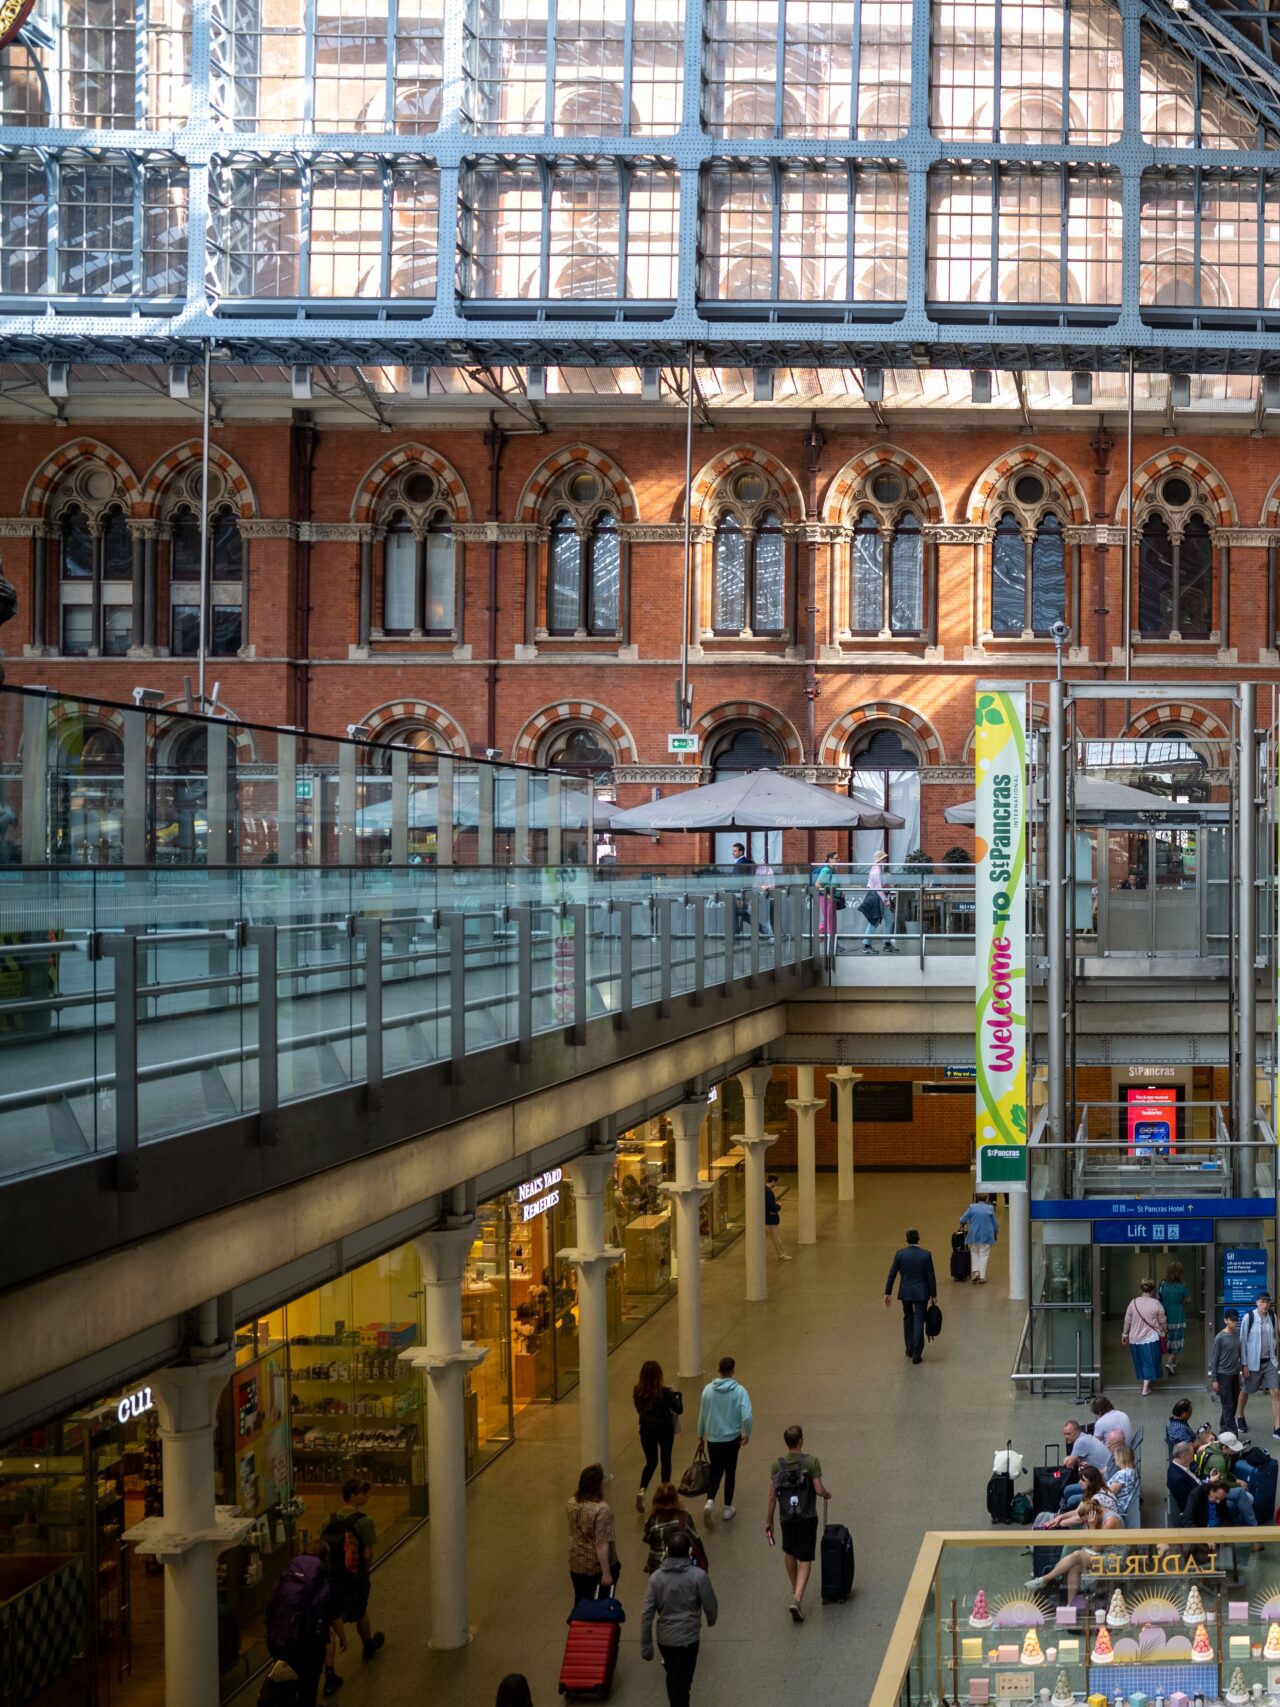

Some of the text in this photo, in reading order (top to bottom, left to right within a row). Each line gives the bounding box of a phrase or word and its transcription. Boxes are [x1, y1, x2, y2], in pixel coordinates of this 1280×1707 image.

[992, 891, 1011, 925] TO
[986, 937, 1015, 1073] Welcome
[543, 1168, 562, 1188] YARD
[523, 1189, 559, 1222] REMEDIES
[1168, 1205, 1184, 1213] Hotel
[1127, 1224, 1147, 1237] Lift
